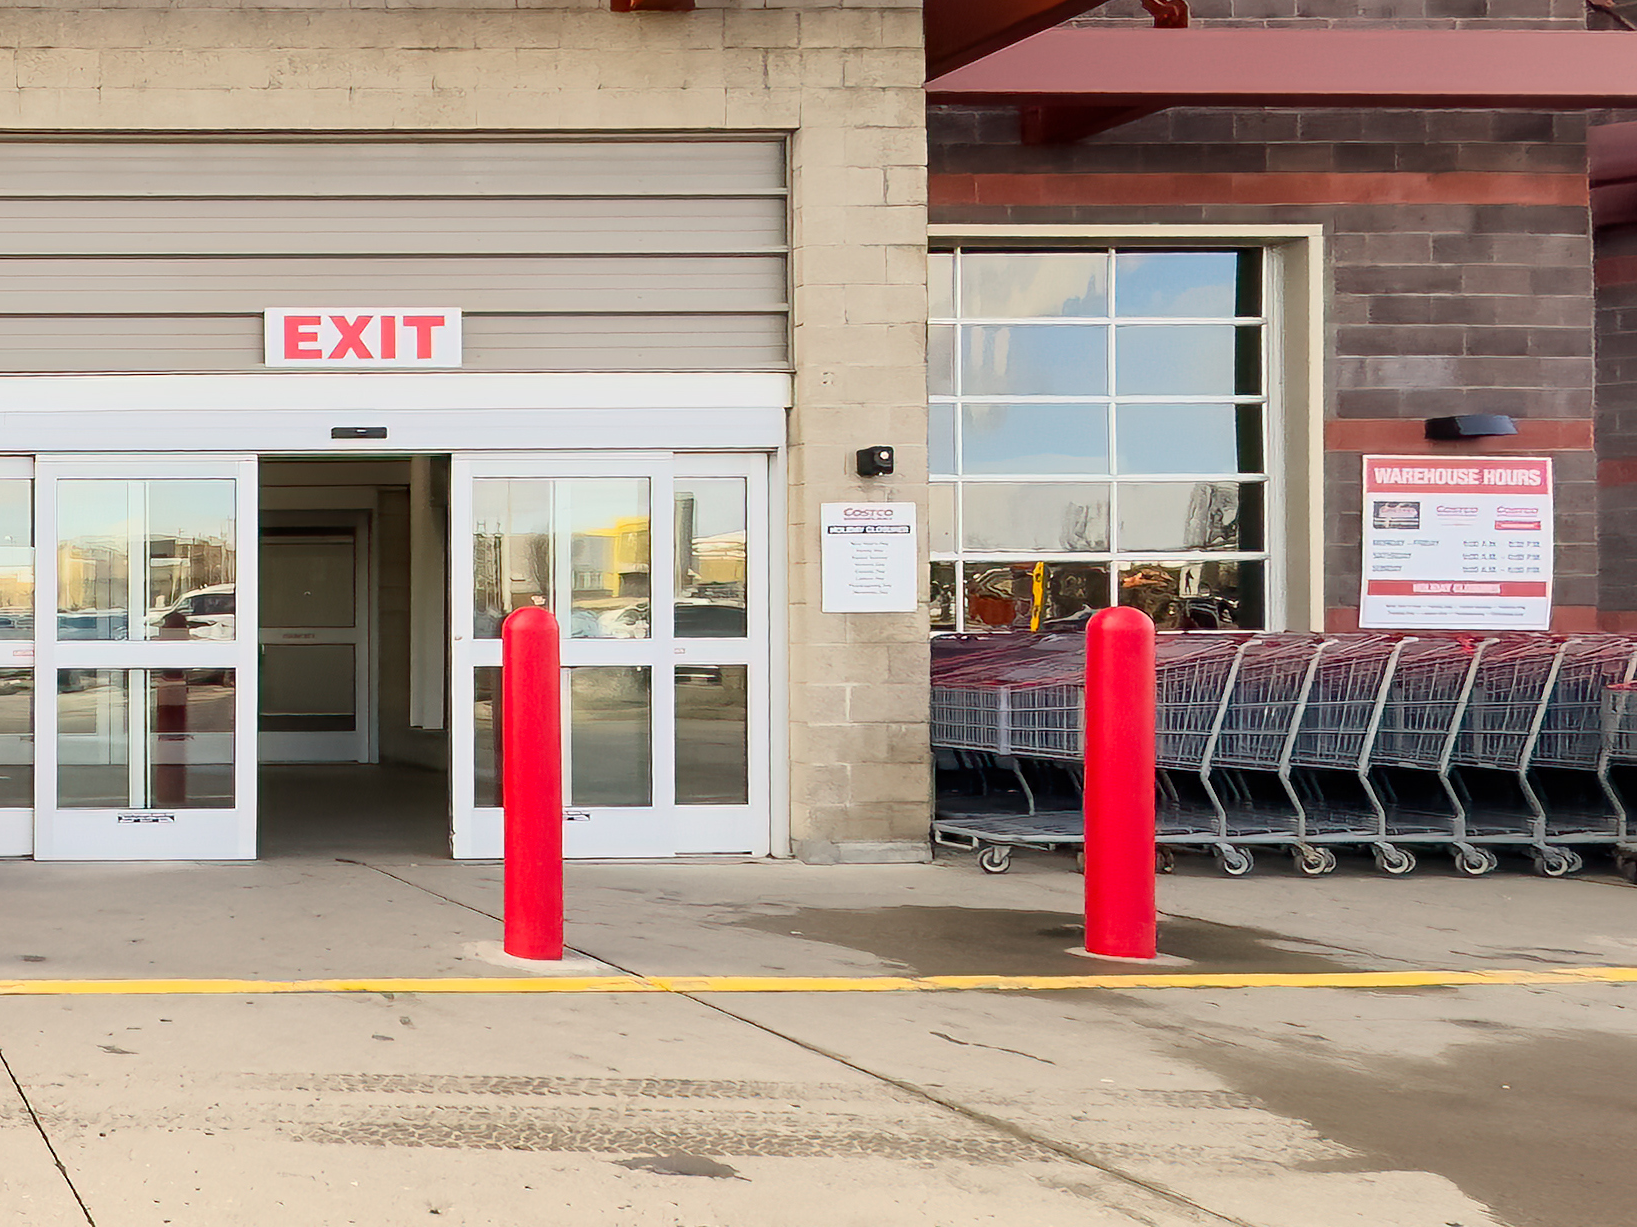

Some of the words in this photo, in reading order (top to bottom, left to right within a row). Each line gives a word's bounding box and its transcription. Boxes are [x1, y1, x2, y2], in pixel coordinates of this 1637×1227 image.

[284, 315, 445, 359] EXIT
[1373, 466, 1481, 486] WAREHOUSE
[1482, 468, 1542, 487] HOURS
[843, 507, 894, 517] COSTCO
